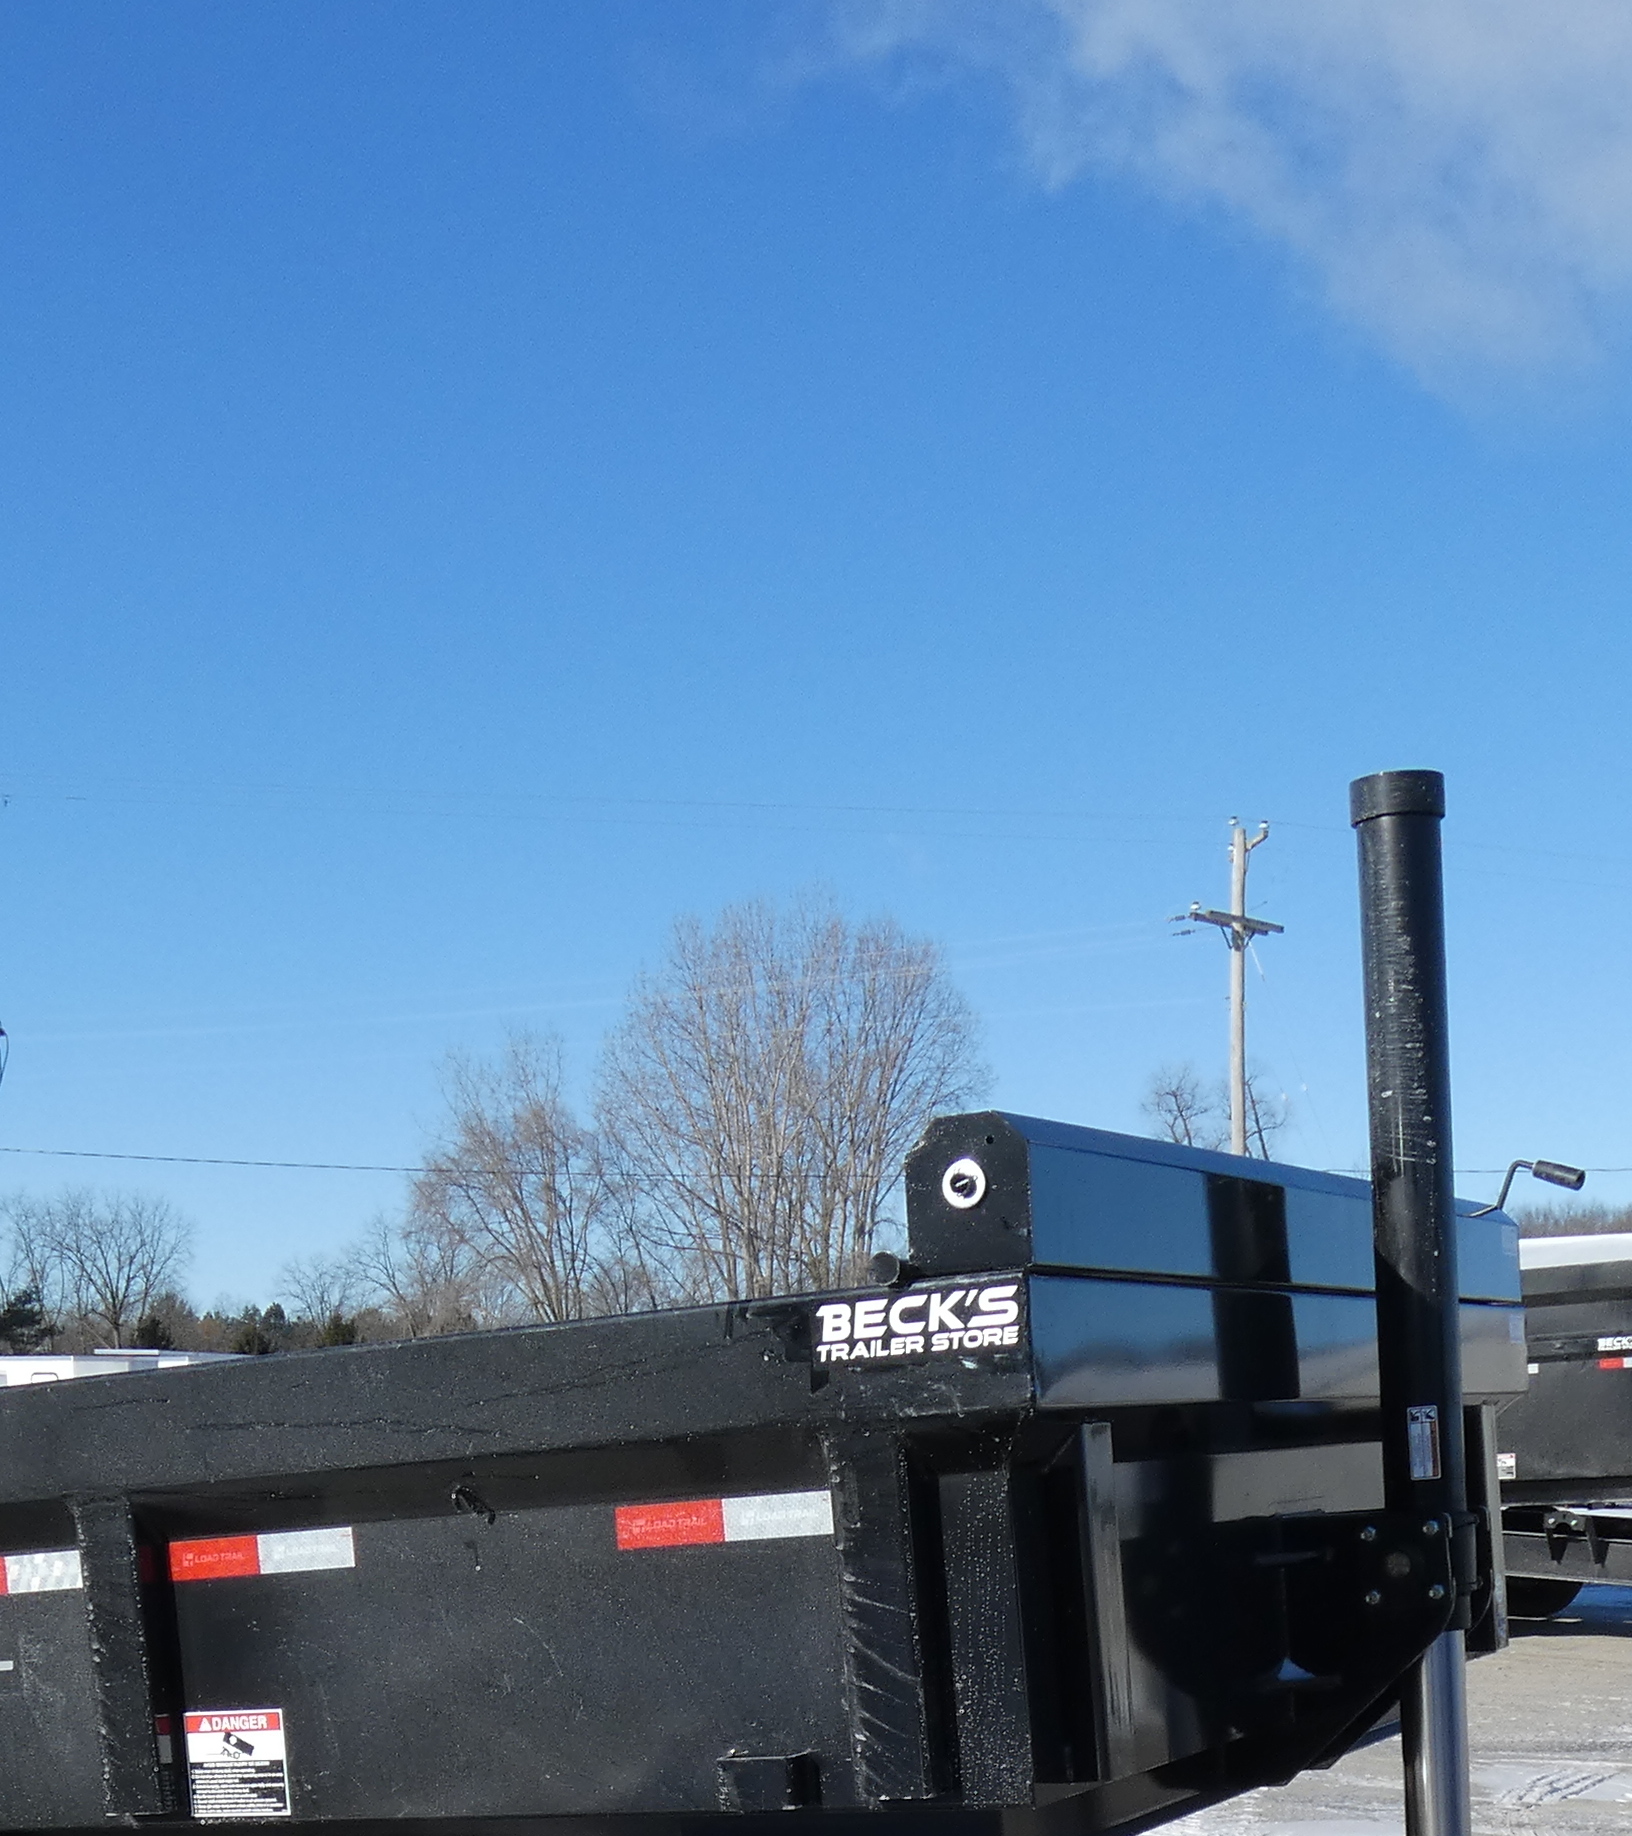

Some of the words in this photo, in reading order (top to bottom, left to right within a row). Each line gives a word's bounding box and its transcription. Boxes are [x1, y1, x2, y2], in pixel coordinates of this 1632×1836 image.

[816, 1285, 1018, 1342] BECK'S
[816, 1335, 924, 1363] TRAILER
[930, 1325, 1019, 1352] STORE
[211, 1715, 268, 1731] DANGER
